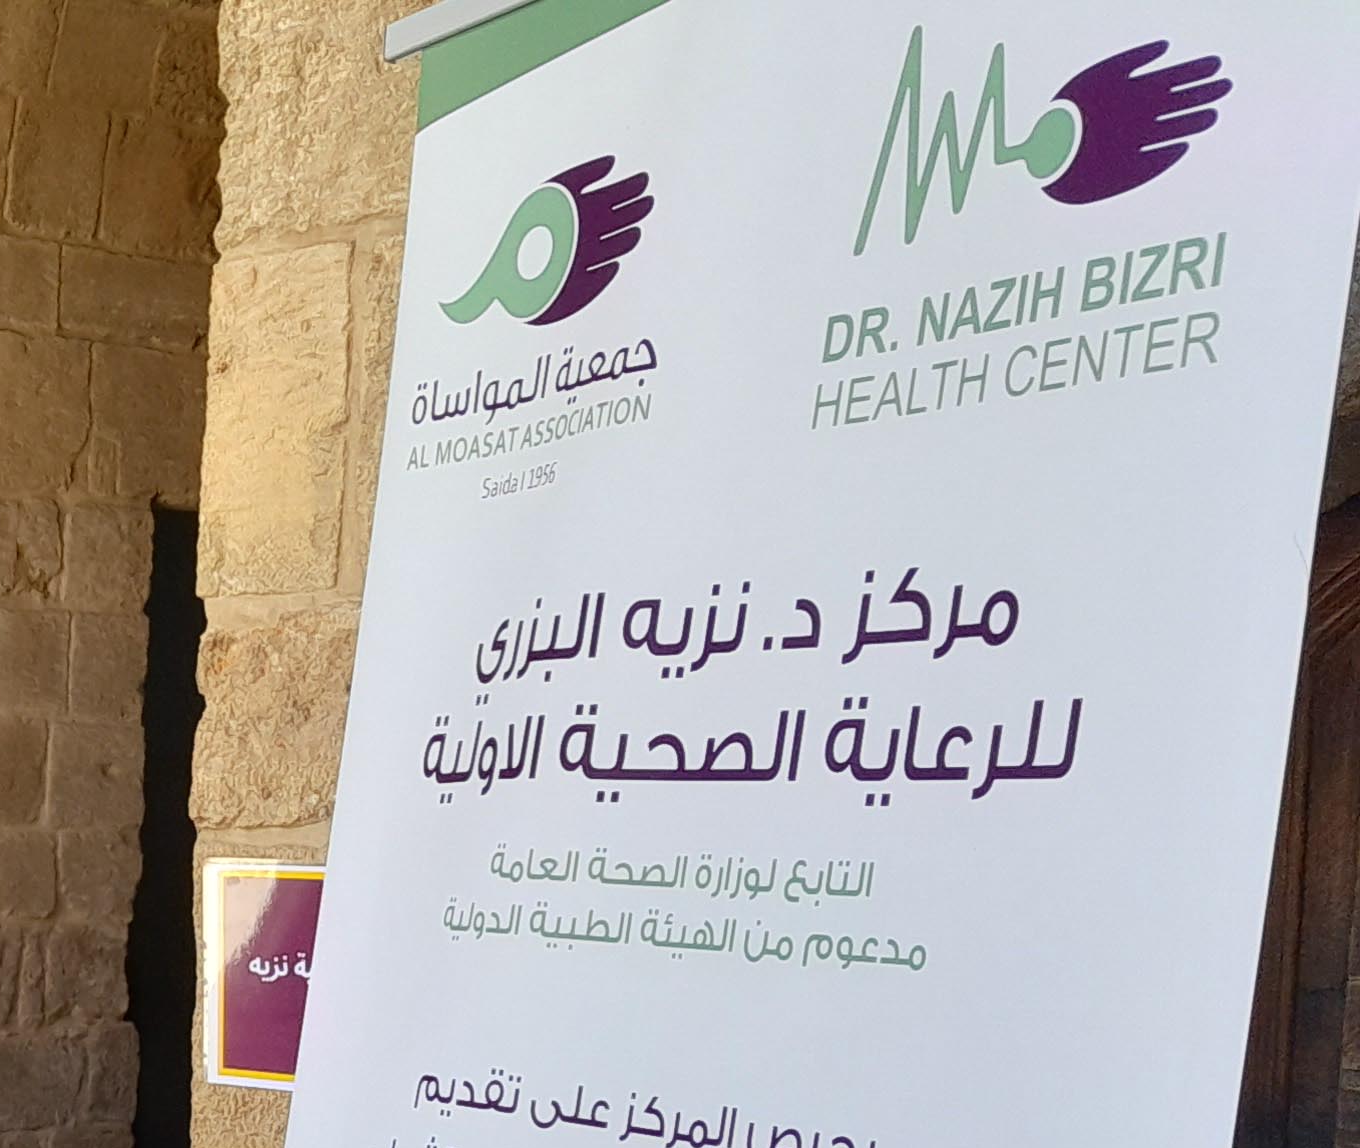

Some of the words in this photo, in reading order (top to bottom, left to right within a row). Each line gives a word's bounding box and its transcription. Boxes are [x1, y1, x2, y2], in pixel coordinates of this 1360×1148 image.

[822, 306, 898, 363] DR.
[917, 266, 1064, 345] NAZIH
[1080, 232, 1227, 312] BIZRI
[411, 354, 551, 425] المواساة
[555, 338, 657, 405] جمعية
[811, 353, 990, 430] HEALTH
[1004, 311, 1220, 397] CENTER
[406, 446, 429, 471] AL
[435, 426, 519, 466] MOASAT
[520, 393, 652, 450] ASSOCIATION
[481, 473, 518, 499] Saida
[527, 461, 558, 489] 1956
[622, 580, 751, 679] نزيه
[763, 597, 822, 652] د.
[842, 567, 1020, 663] مركز
[560, 703, 806, 803] الصحية
[824, 696, 1084, 807] للرعاية
[489, 843, 580, 883] العامة
[587, 847, 688, 890] الصحة
[695, 851, 776, 900] لوزارة
[784, 861, 875, 906] التابع
[443, 896, 521, 942] الدولية
[528, 899, 631, 952] الطبية
[639, 907, 736, 960] الهيئة
[743, 921, 794, 962] من
[248, 955, 288, 982] نزيه
[802, 928, 928, 972] مدعوم
[414, 1067, 522, 1117] تقديم
[530, 1084, 610, 1130] على
